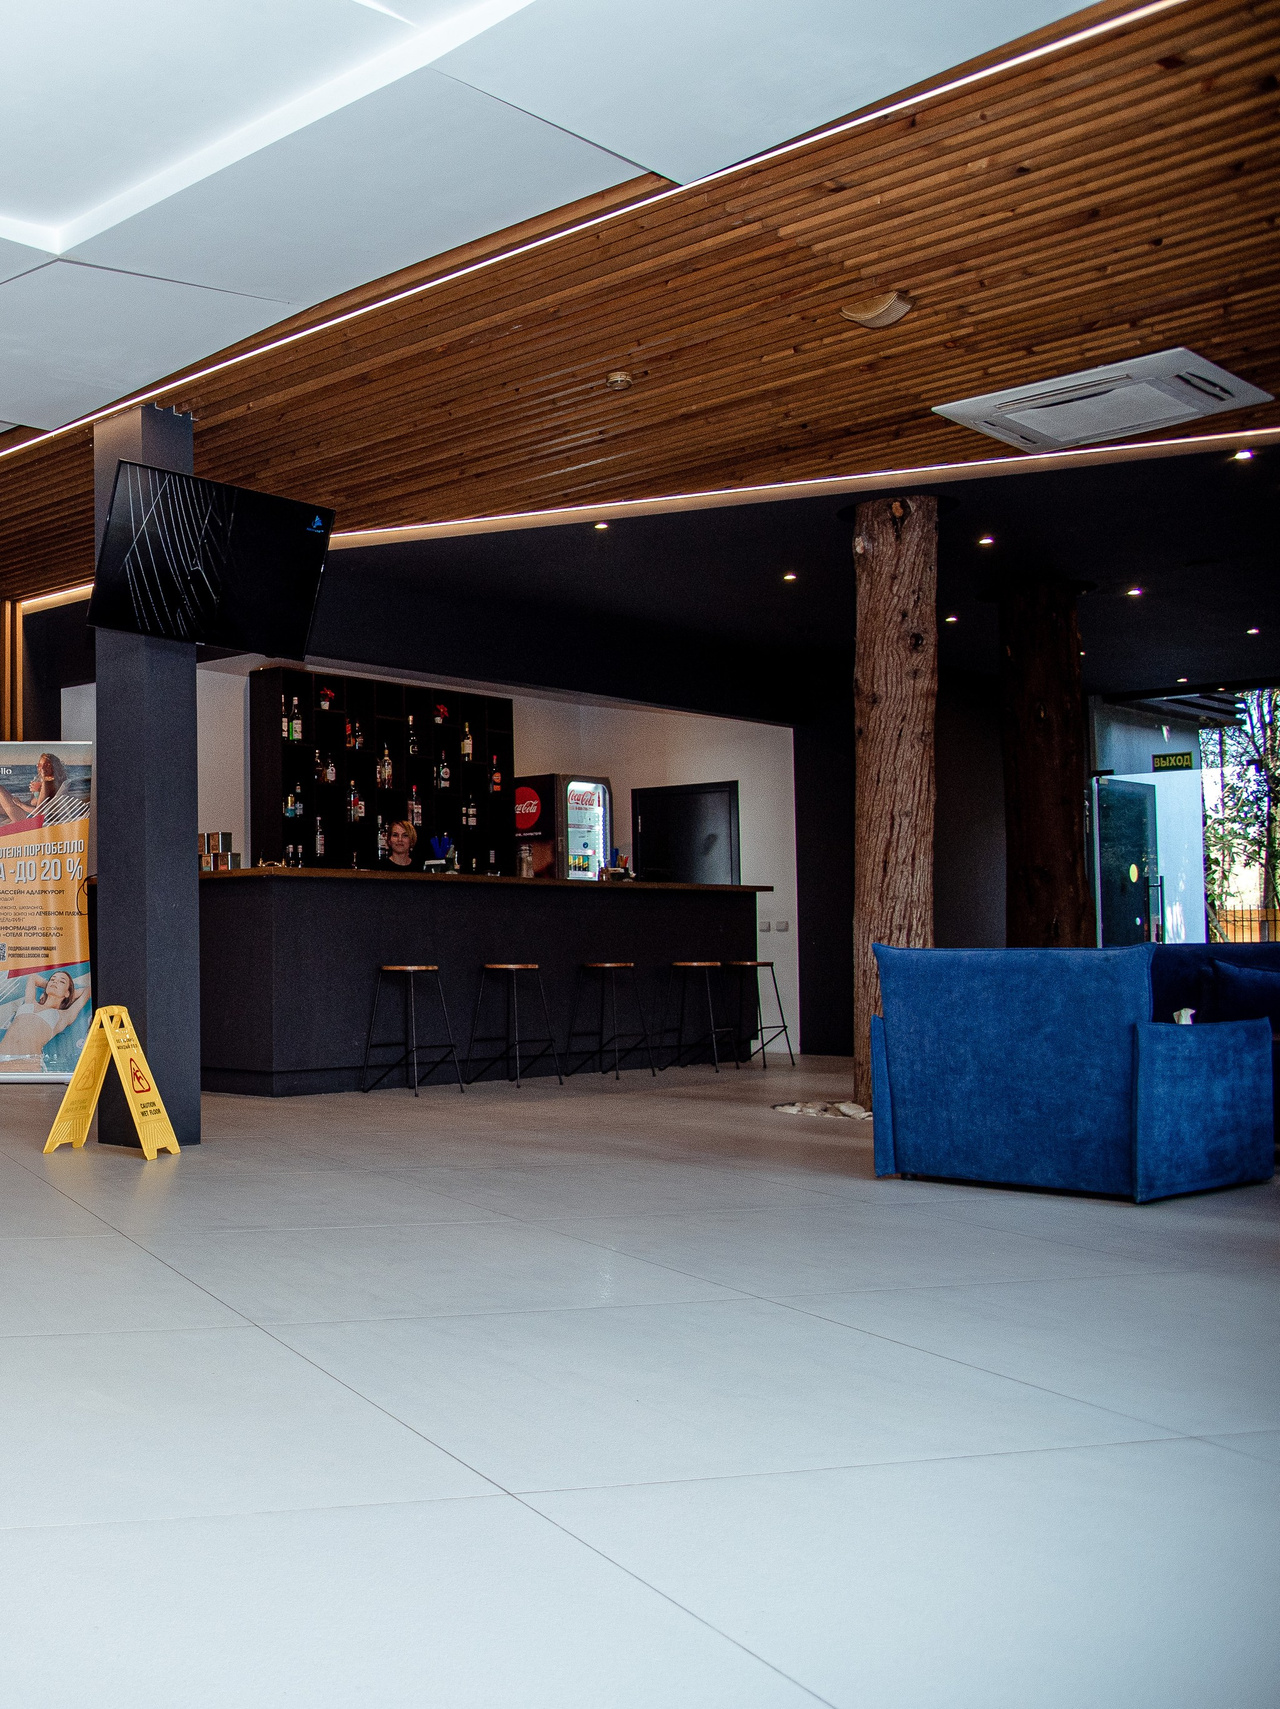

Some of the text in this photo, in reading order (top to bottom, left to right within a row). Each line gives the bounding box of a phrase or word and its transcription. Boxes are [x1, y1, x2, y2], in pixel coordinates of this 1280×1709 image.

[1154, 755, 1191, 767] ВЫХОД
[24, 839, 84, 857] ПОРТОБЕЛЛО
[9, 860, 37, 883] -ДО
[41, 858, 62, 881] 20
[67, 857, 84, 881] %
